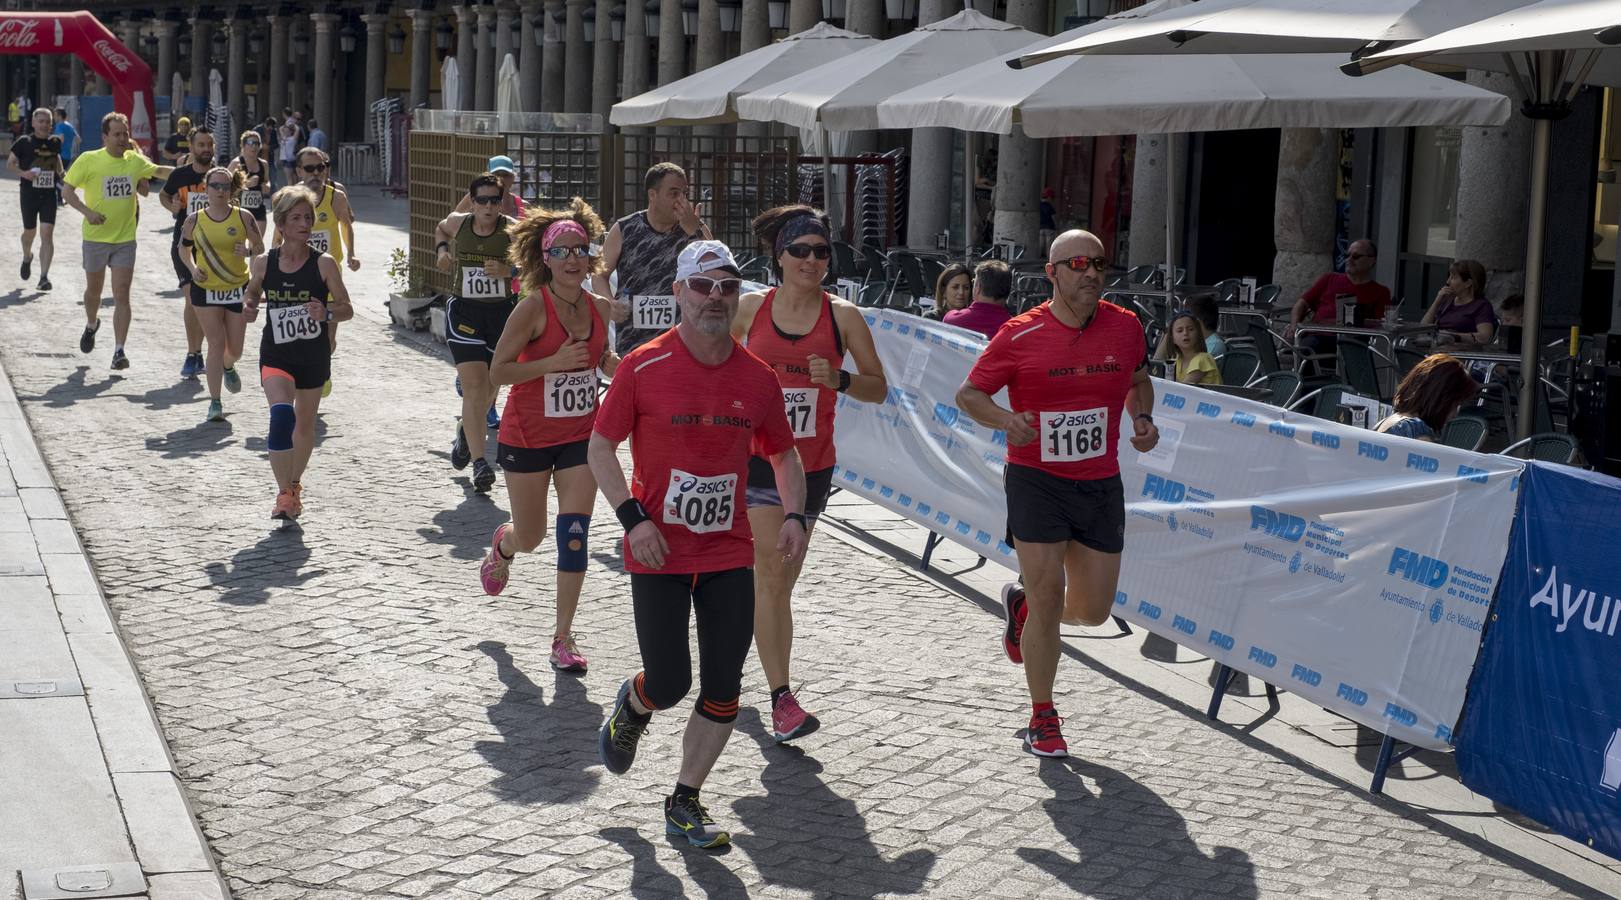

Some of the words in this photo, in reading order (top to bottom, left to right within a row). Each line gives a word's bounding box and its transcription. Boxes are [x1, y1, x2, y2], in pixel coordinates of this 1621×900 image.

[107, 183, 132, 196] 1212
[210, 289, 241, 300] 1024
[468, 278, 499, 294] 1011
[287, 308, 309, 318] asics
[649, 298, 669, 306] asics
[639, 307, 673, 325] 1175
[277, 317, 318, 339] 1048
[568, 374, 591, 386] asics
[551, 385, 595, 412] 1033
[787, 405, 812, 433] 17
[1066, 413, 1097, 427] asics
[1048, 426, 1102, 456] 1168
[1161, 392, 1186, 411] FMD
[1195, 401, 1222, 420] FMD
[1230, 410, 1258, 429] FMD
[1311, 430, 1341, 450] FMD
[1357, 440, 1390, 462] FMD
[1406, 452, 1440, 475] FMD
[1456, 464, 1489, 485] FMD
[696, 480, 728, 495] asics
[1142, 473, 1185, 504] FMD
[673, 492, 732, 527] 1085
[1250, 505, 1306, 543] FMD
[1310, 521, 1345, 538] Fundación
[1305, 539, 1314, 549] de
[1315, 543, 1350, 561] Deportes
[1306, 530, 1343, 548] Municipal
[1243, 541, 1288, 564] Ayuntamiento
[1303, 561, 1313, 573] de
[1313, 563, 1346, 584] Valladolid
[1388, 546, 1450, 591] FMD
[1453, 565, 1494, 585] Fundación
[1447, 586, 1458, 597] de
[1458, 590, 1490, 608] Deport
[1450, 576, 1490, 596] Municipal
[1380, 587, 1427, 613] Ayuntamiento
[1446, 610, 1457, 624] de
[1137, 600, 1162, 621] FMD
[1172, 614, 1198, 635] FMD
[1208, 630, 1235, 651] FMD
[1248, 646, 1278, 670] FMD
[1291, 664, 1322, 688] FMD
[1336, 682, 1369, 707] FMD
[1383, 702, 1418, 728] FMD
